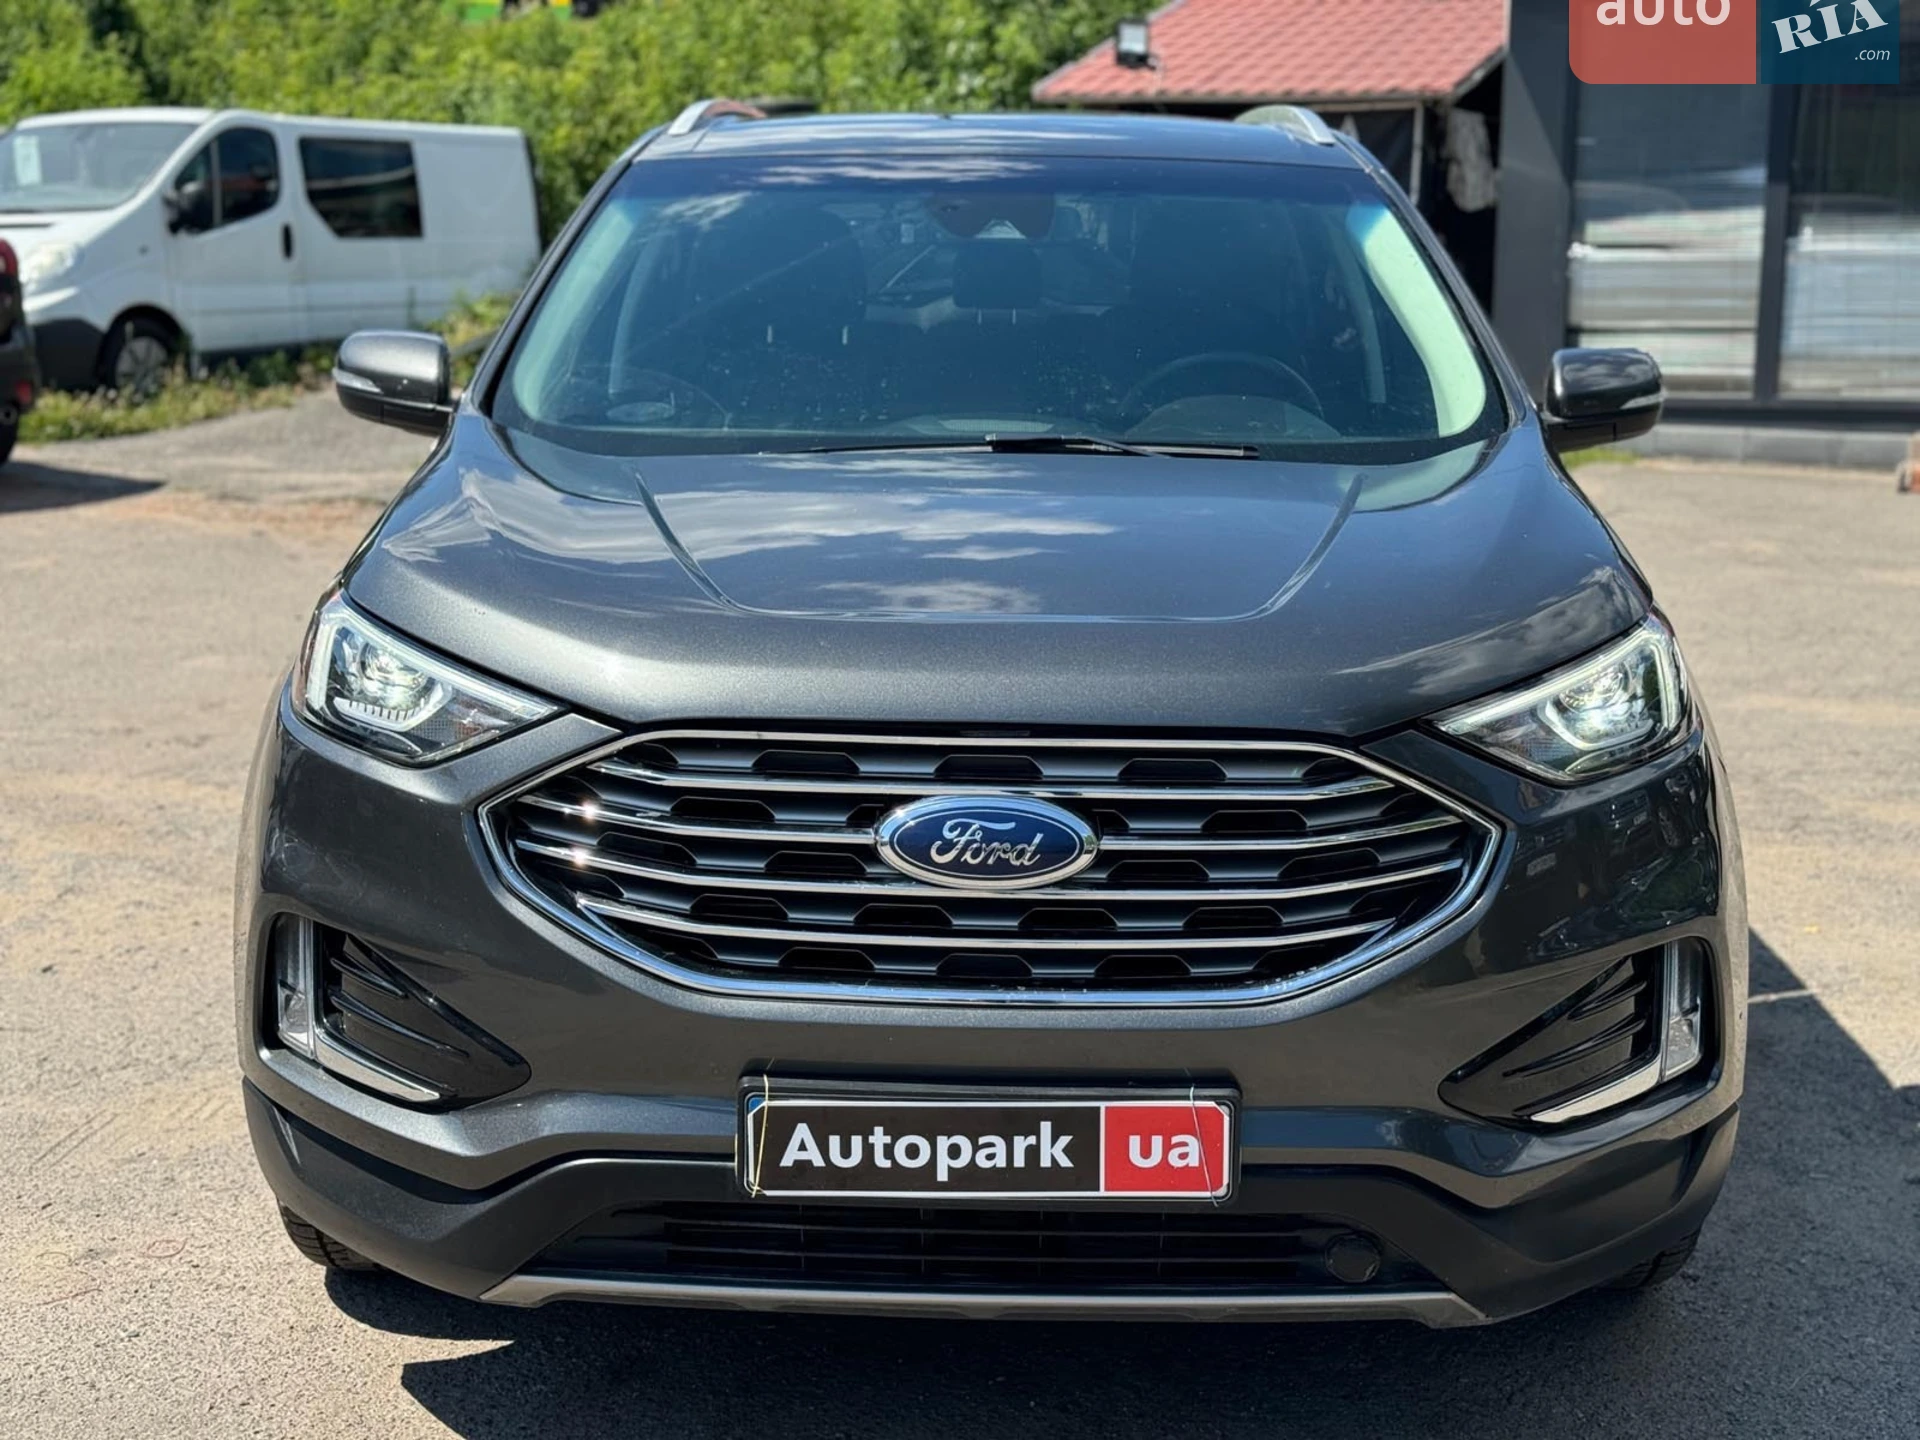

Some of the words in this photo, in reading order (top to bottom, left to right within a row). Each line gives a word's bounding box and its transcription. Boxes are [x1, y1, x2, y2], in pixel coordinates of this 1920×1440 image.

[930, 818, 1044, 867] Ford
[779, 1121, 1074, 1182] Autopark
[1128, 1134, 1201, 1169] ua
